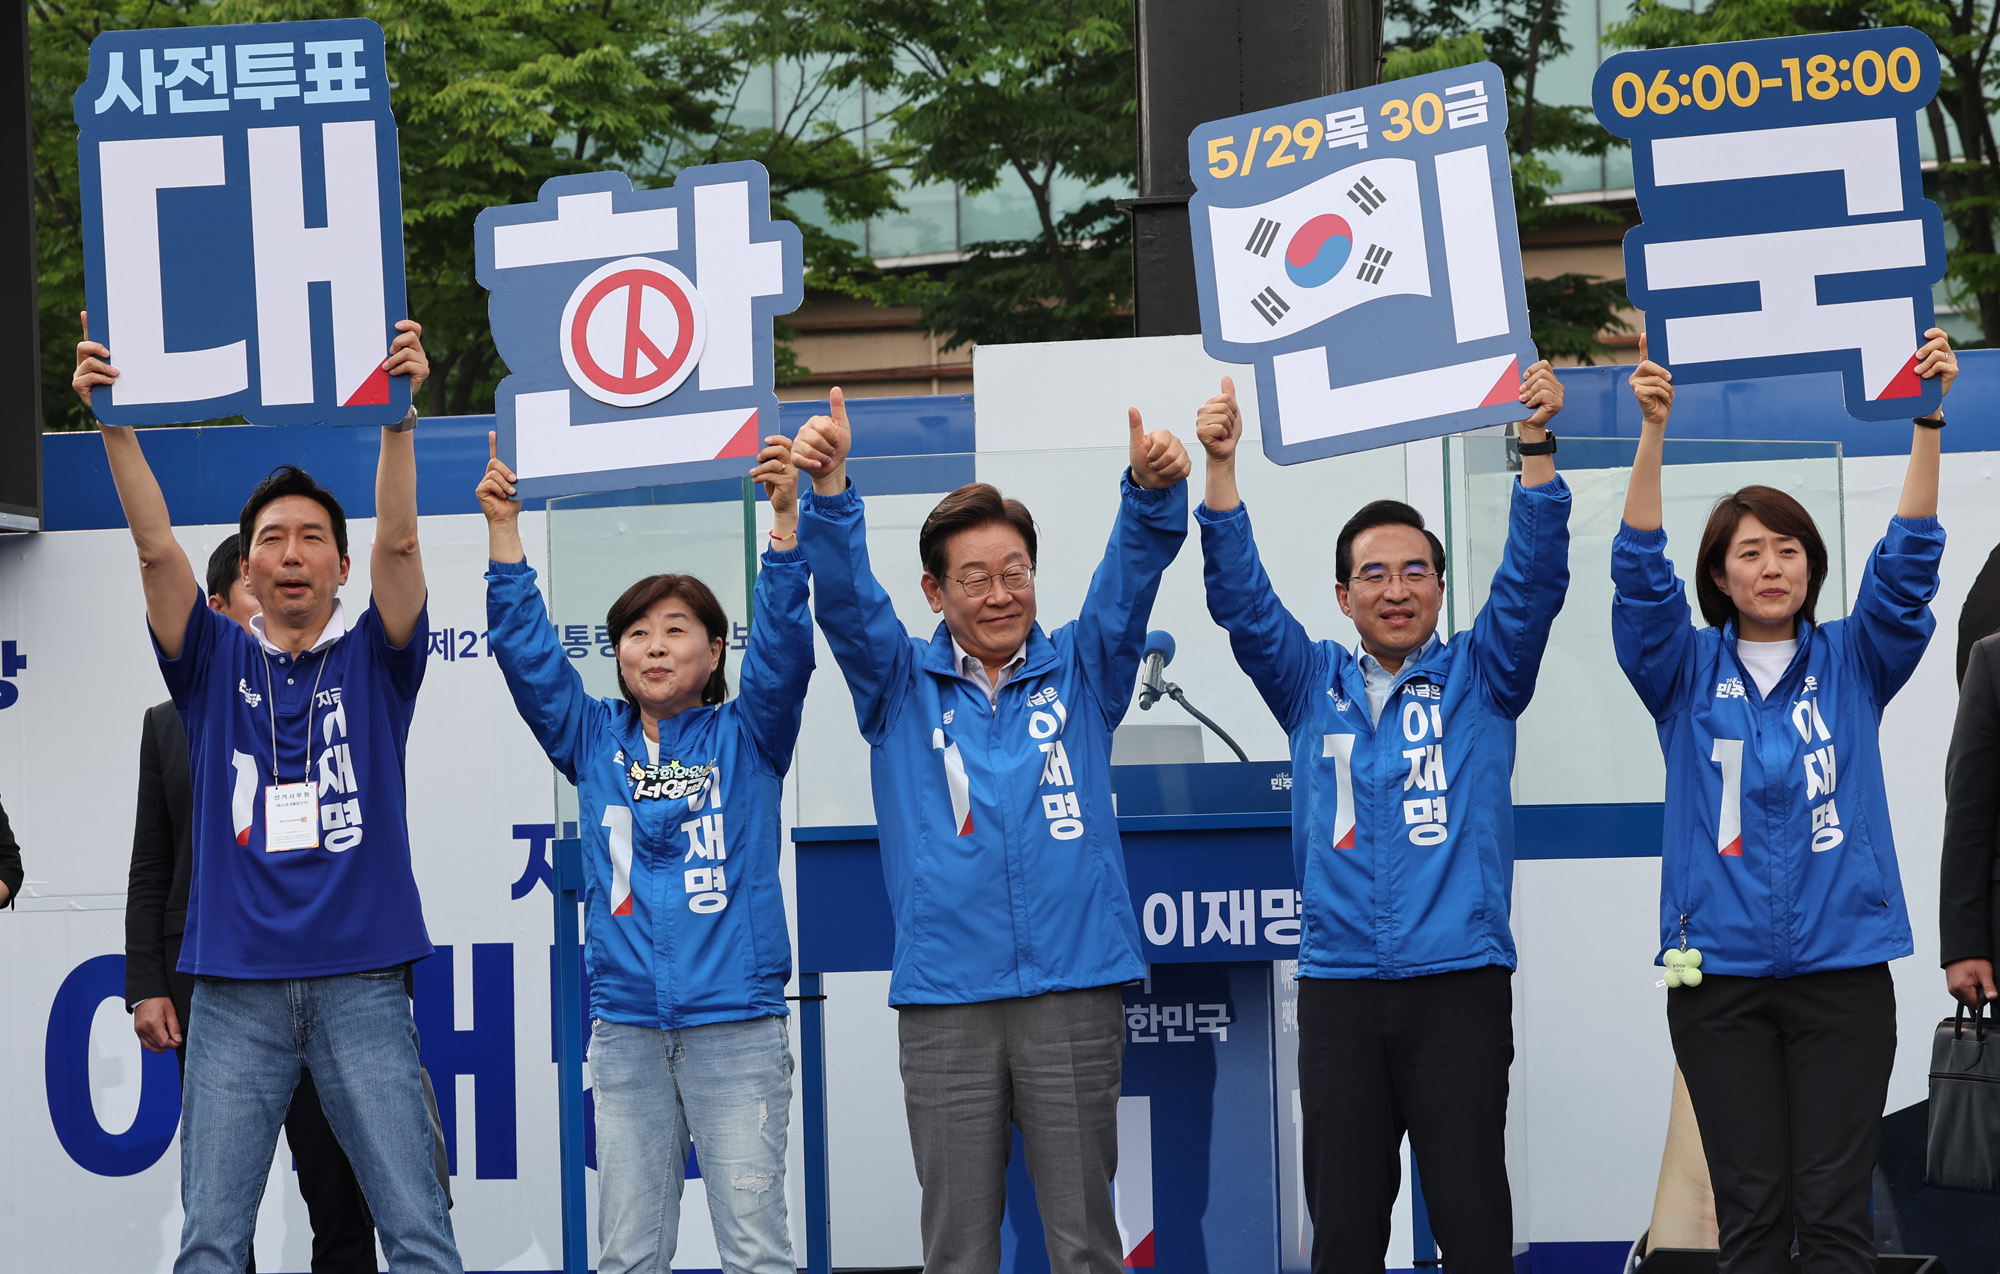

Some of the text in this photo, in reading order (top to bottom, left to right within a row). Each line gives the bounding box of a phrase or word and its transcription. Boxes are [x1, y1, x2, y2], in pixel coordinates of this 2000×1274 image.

[95, 38, 370, 115] 사전투표
[1611, 46, 1921, 118] 06:00-18:00
[1207, 80, 1489, 178] 5/29목 30금
[99, 120, 390, 406] 대
[1644, 117, 1926, 401] 국
[494, 180, 783, 479] 한
[428, 628, 493, 662] 제21
[1402, 683, 1441, 700] 지금은
[231, 748, 259, 846] 1
[274, 791, 310, 801] 선거사무원
[645, 764, 703, 780] 국회의원
[1028, 698, 1084, 840] 이재명
[1322, 733, 1357, 849] 1
[1402, 701, 1448, 846] 이재명
[1711, 738, 1744, 857] 1
[1791, 696, 1844, 852] 이재명
[601, 804, 633, 916] 1
[1143, 889, 1302, 948] 이재명
[1122, 1003, 1231, 1043] 한민국
